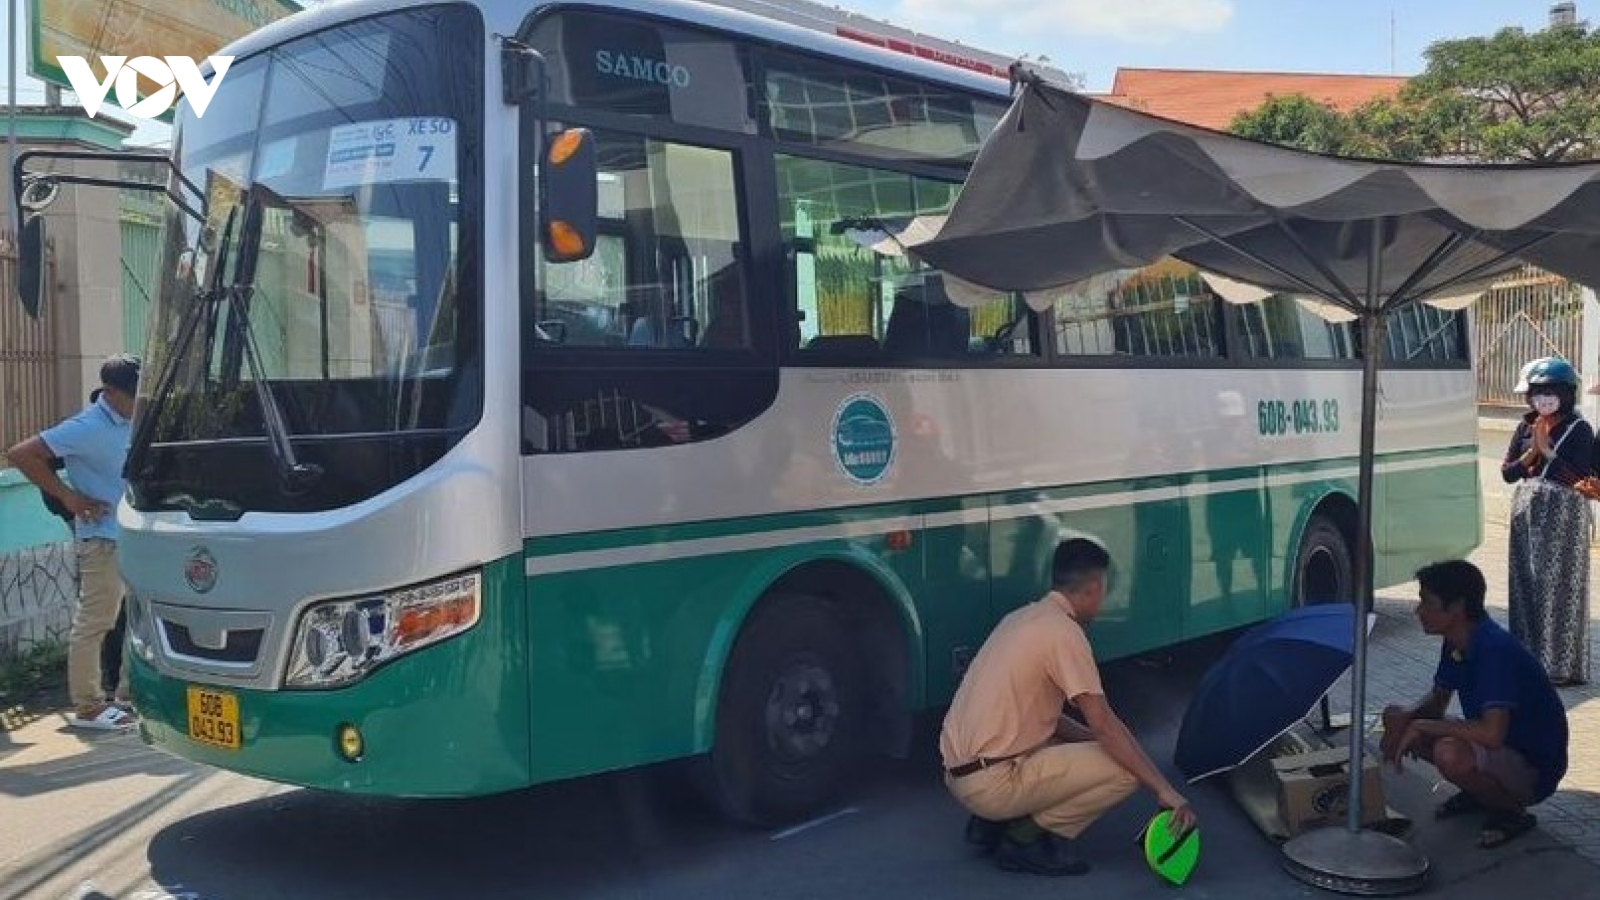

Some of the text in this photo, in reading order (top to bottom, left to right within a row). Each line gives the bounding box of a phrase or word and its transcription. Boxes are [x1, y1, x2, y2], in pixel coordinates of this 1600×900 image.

[596, 49, 691, 87] SAMCO
[407, 119, 428, 135] XE
[417, 145, 435, 172] 7
